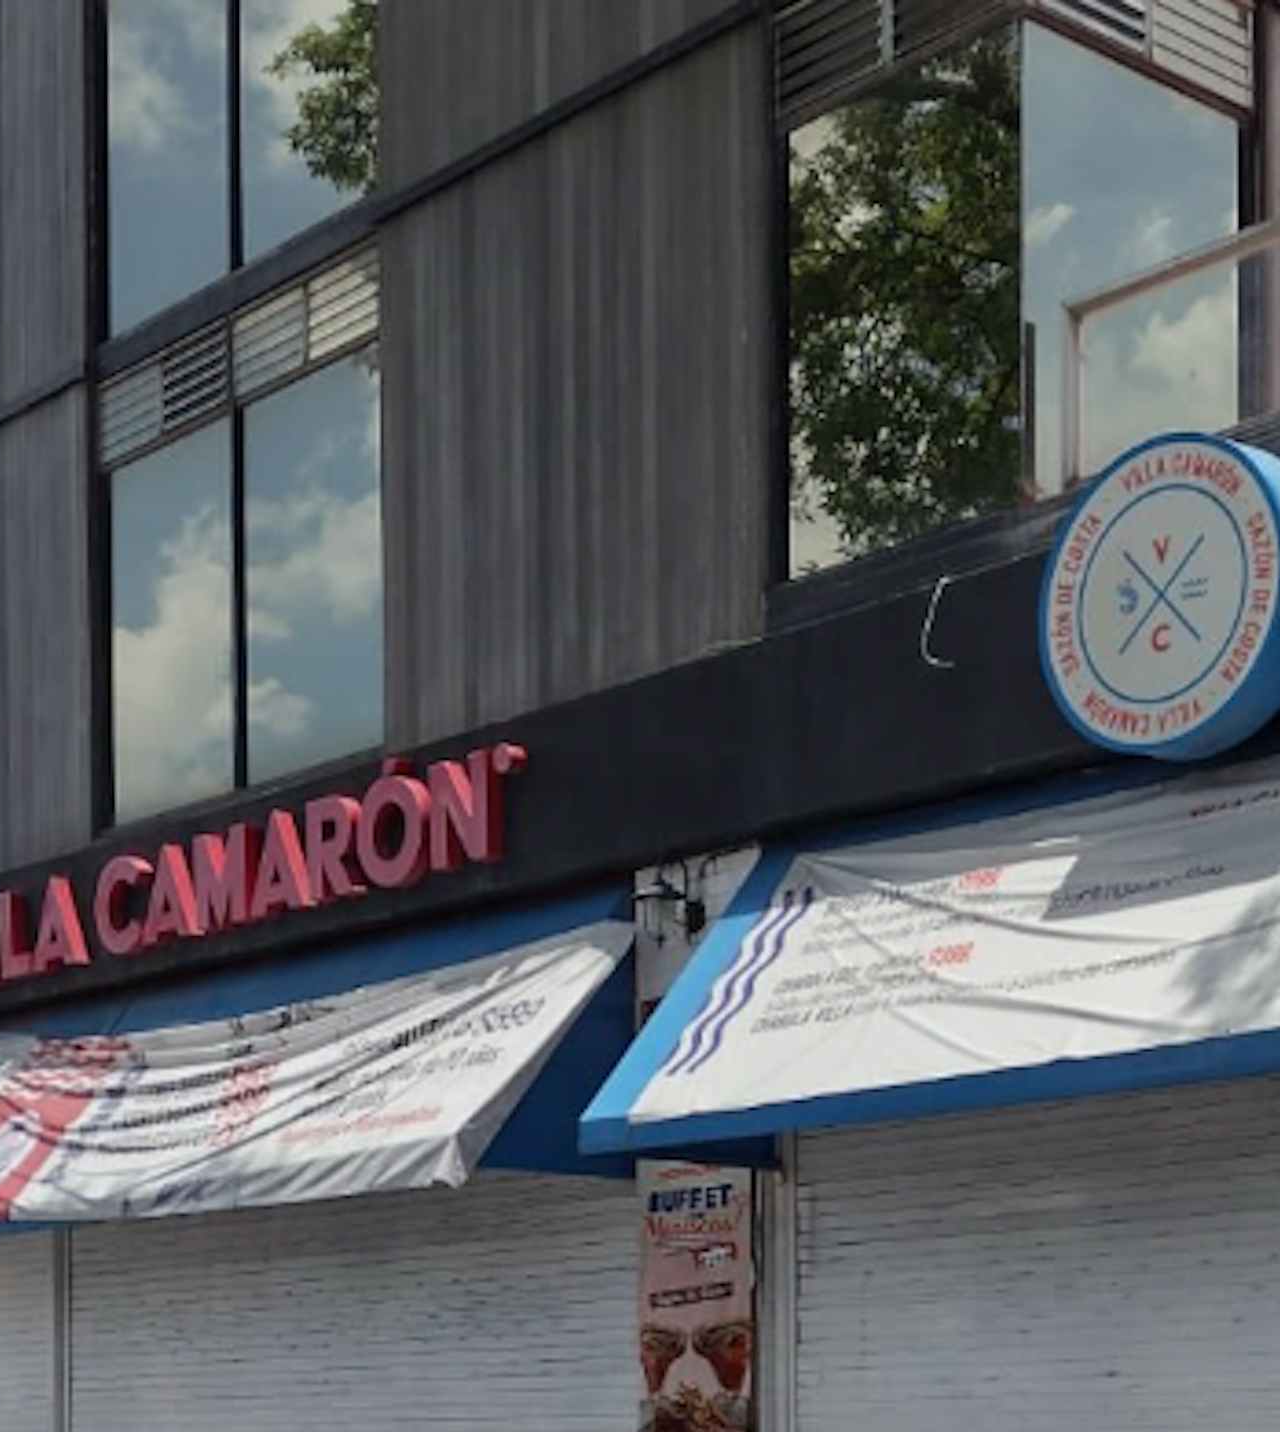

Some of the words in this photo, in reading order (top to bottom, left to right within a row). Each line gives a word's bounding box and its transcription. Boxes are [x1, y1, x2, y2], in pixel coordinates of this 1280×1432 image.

[1152, 535, 1170, 563] V
[1151, 624, 1171, 652] C
[93, 745, 505, 955] CAMARÓN
